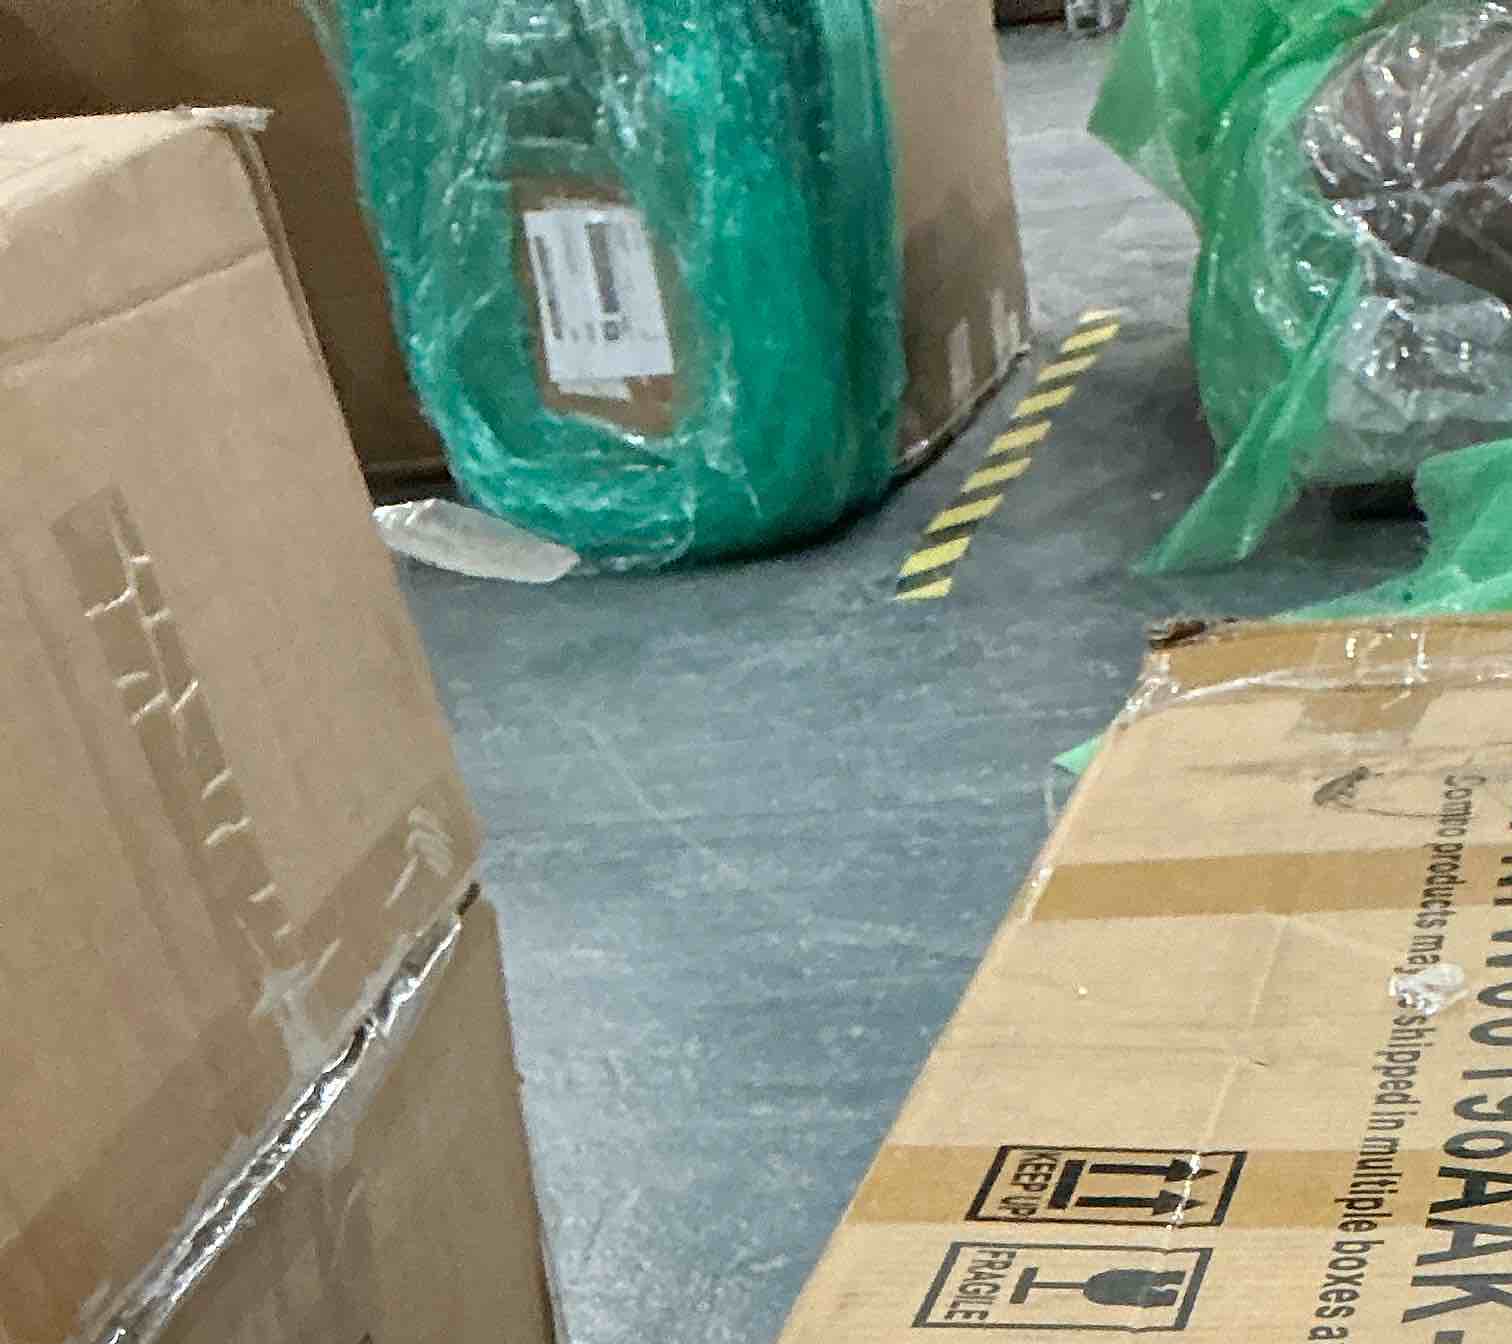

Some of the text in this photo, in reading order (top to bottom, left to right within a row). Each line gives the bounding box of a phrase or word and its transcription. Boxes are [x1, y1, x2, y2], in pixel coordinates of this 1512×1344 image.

[1414, 843, 1466, 929] products
[1373, 1015, 1433, 1106] shipped
[1367, 1111, 1418, 1131] in
[997, 1151, 1063, 1218] KEEP UP
[1335, 1136, 1403, 1233] multiple
[943, 1249, 1017, 1321] FRAGILE
[1315, 1240, 1384, 1318] boxes
